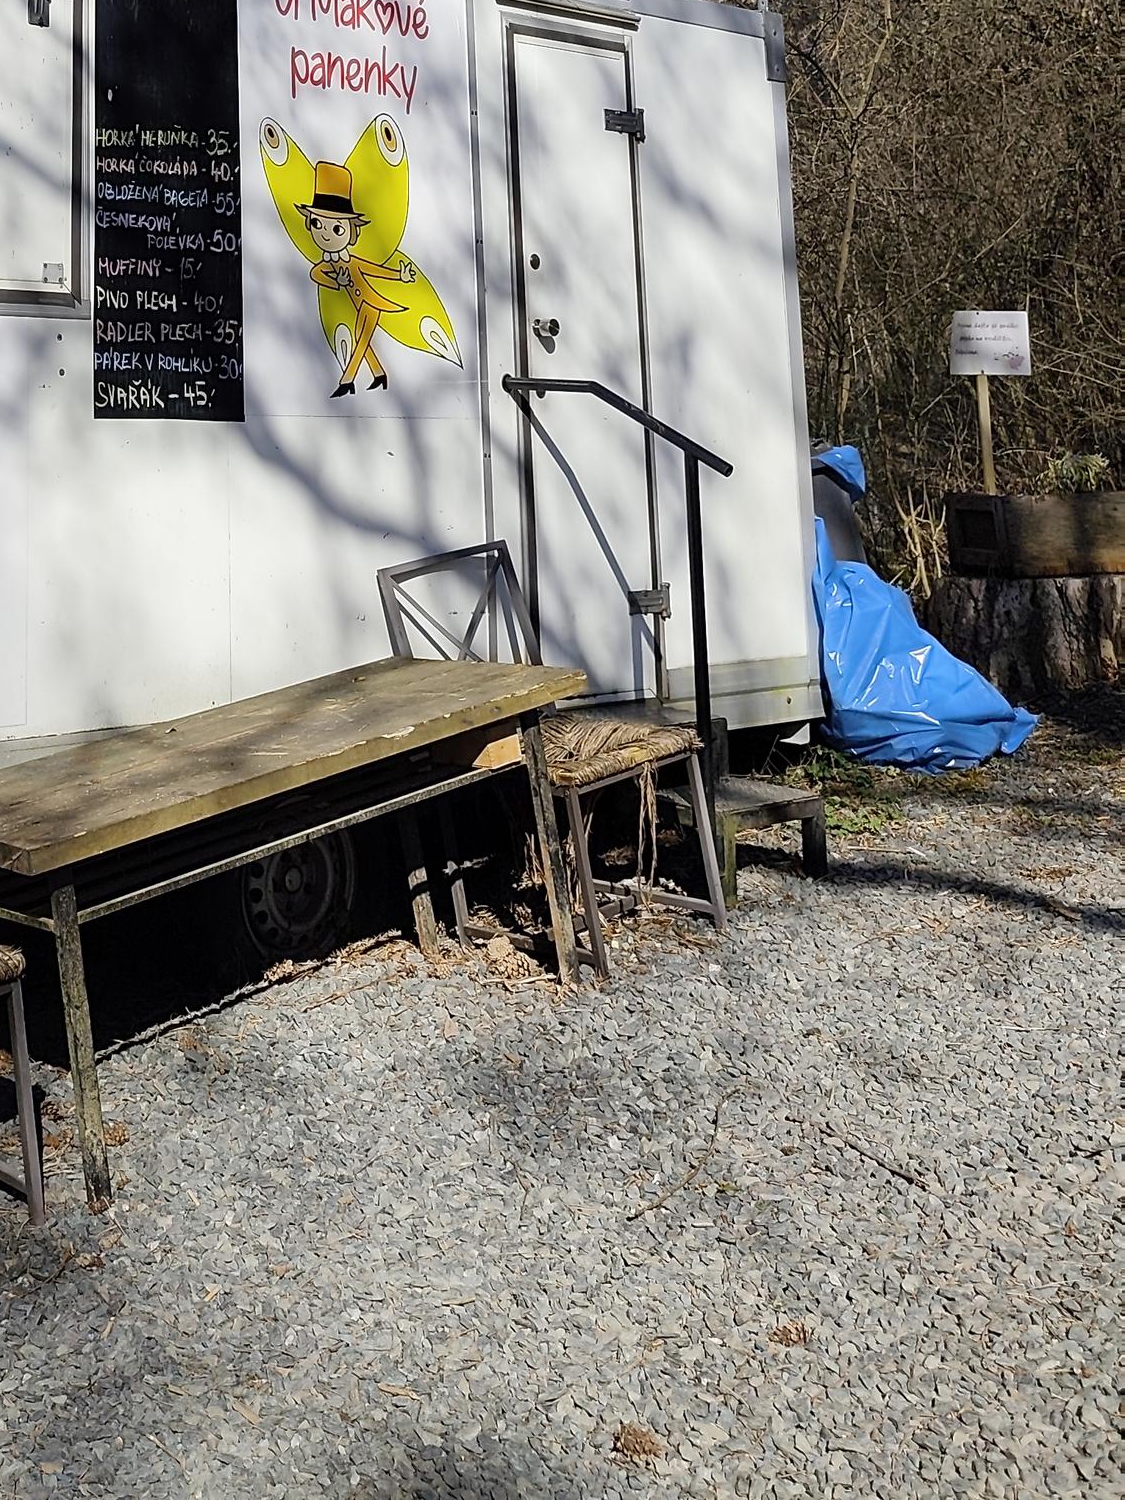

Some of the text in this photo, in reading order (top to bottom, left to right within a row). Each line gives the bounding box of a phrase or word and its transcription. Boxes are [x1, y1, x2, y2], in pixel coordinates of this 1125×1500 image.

[290, 45, 418, 115] panenky
[96, 152, 139, 175] HORKÁ
[163, 188, 208, 209] BAGETA
[95, 206, 177, 232] ČESNEKOVÁ
[98, 257, 162, 278] MUFFINY
[95, 285, 129, 309] PIVO
[136, 291, 178, 313] PLECH
[96, 318, 156, 344] RADLER
[160, 323, 203, 342] PLECH
[94, 347, 142, 372] PÁREK
[144, 352, 154, 371] V
[158, 348, 213, 375] ROHLÍKU
[95, 378, 165, 410] SVAŘÁK
